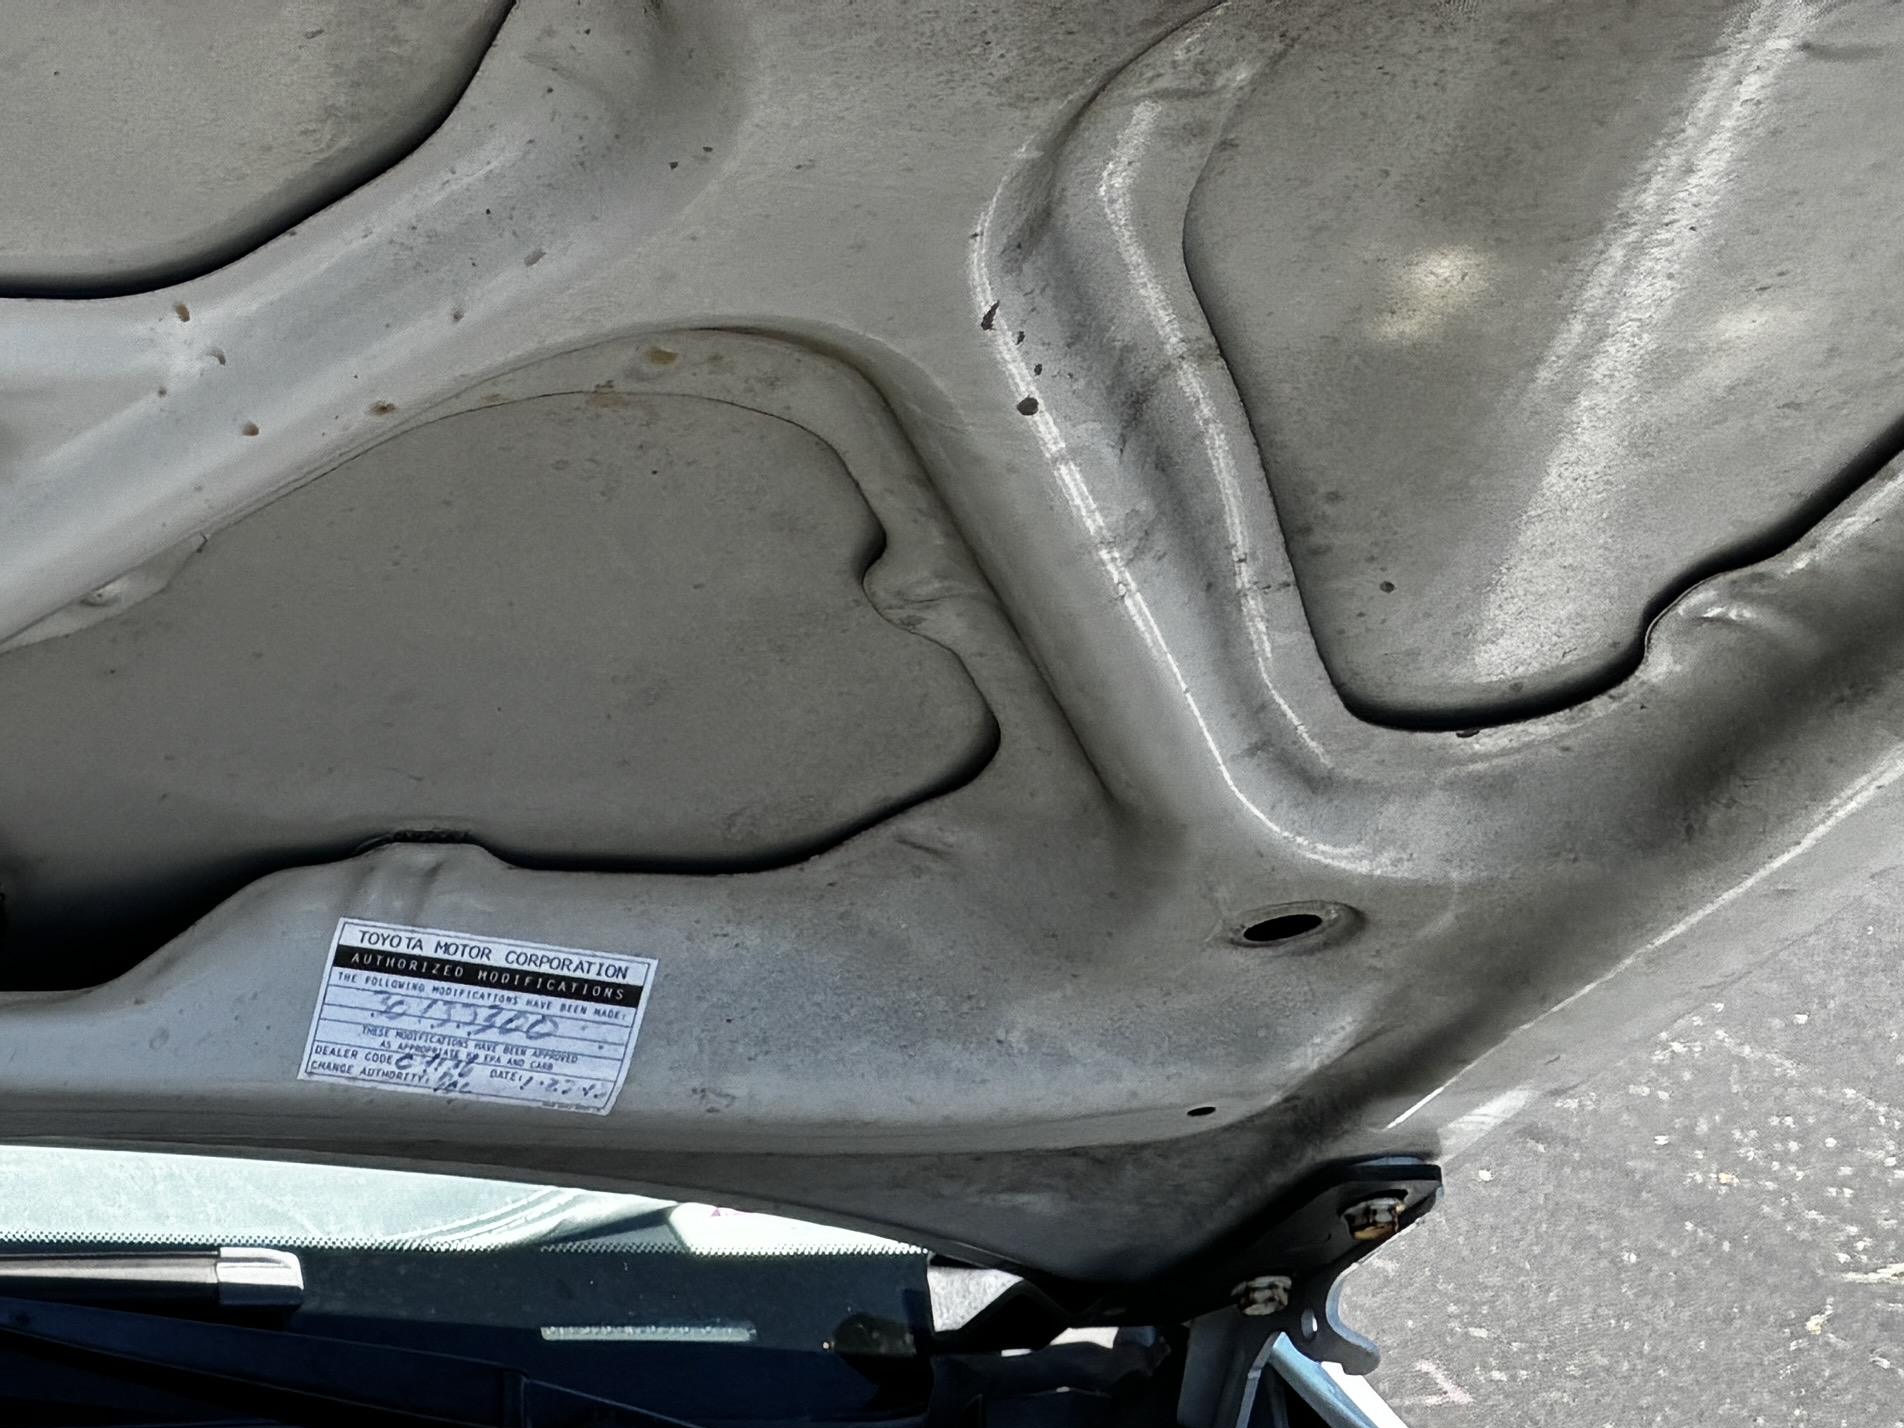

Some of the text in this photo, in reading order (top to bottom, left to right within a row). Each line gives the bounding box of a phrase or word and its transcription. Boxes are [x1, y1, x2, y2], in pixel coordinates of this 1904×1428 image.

[359, 930, 629, 980] TOYOTA MOTOR CORPORATION
[338, 972, 356, 983] THE
[365, 976, 425, 992] FOLLOWING
[432, 986, 518, 1006] MODIFICATIONS
[526, 998, 552, 1010] HAVE
[560, 1003, 587, 1015] BEEN
[351, 953, 624, 1000] AUTHORIZED MODIFICATIONS
[310, 1060, 353, 1075] CHANGE
[315, 1045, 359, 1059] DEALER
[364, 1052, 393, 1066] CODE
[380, 1040, 392, 1049] AS
[507, 1057, 525, 1068] AND
